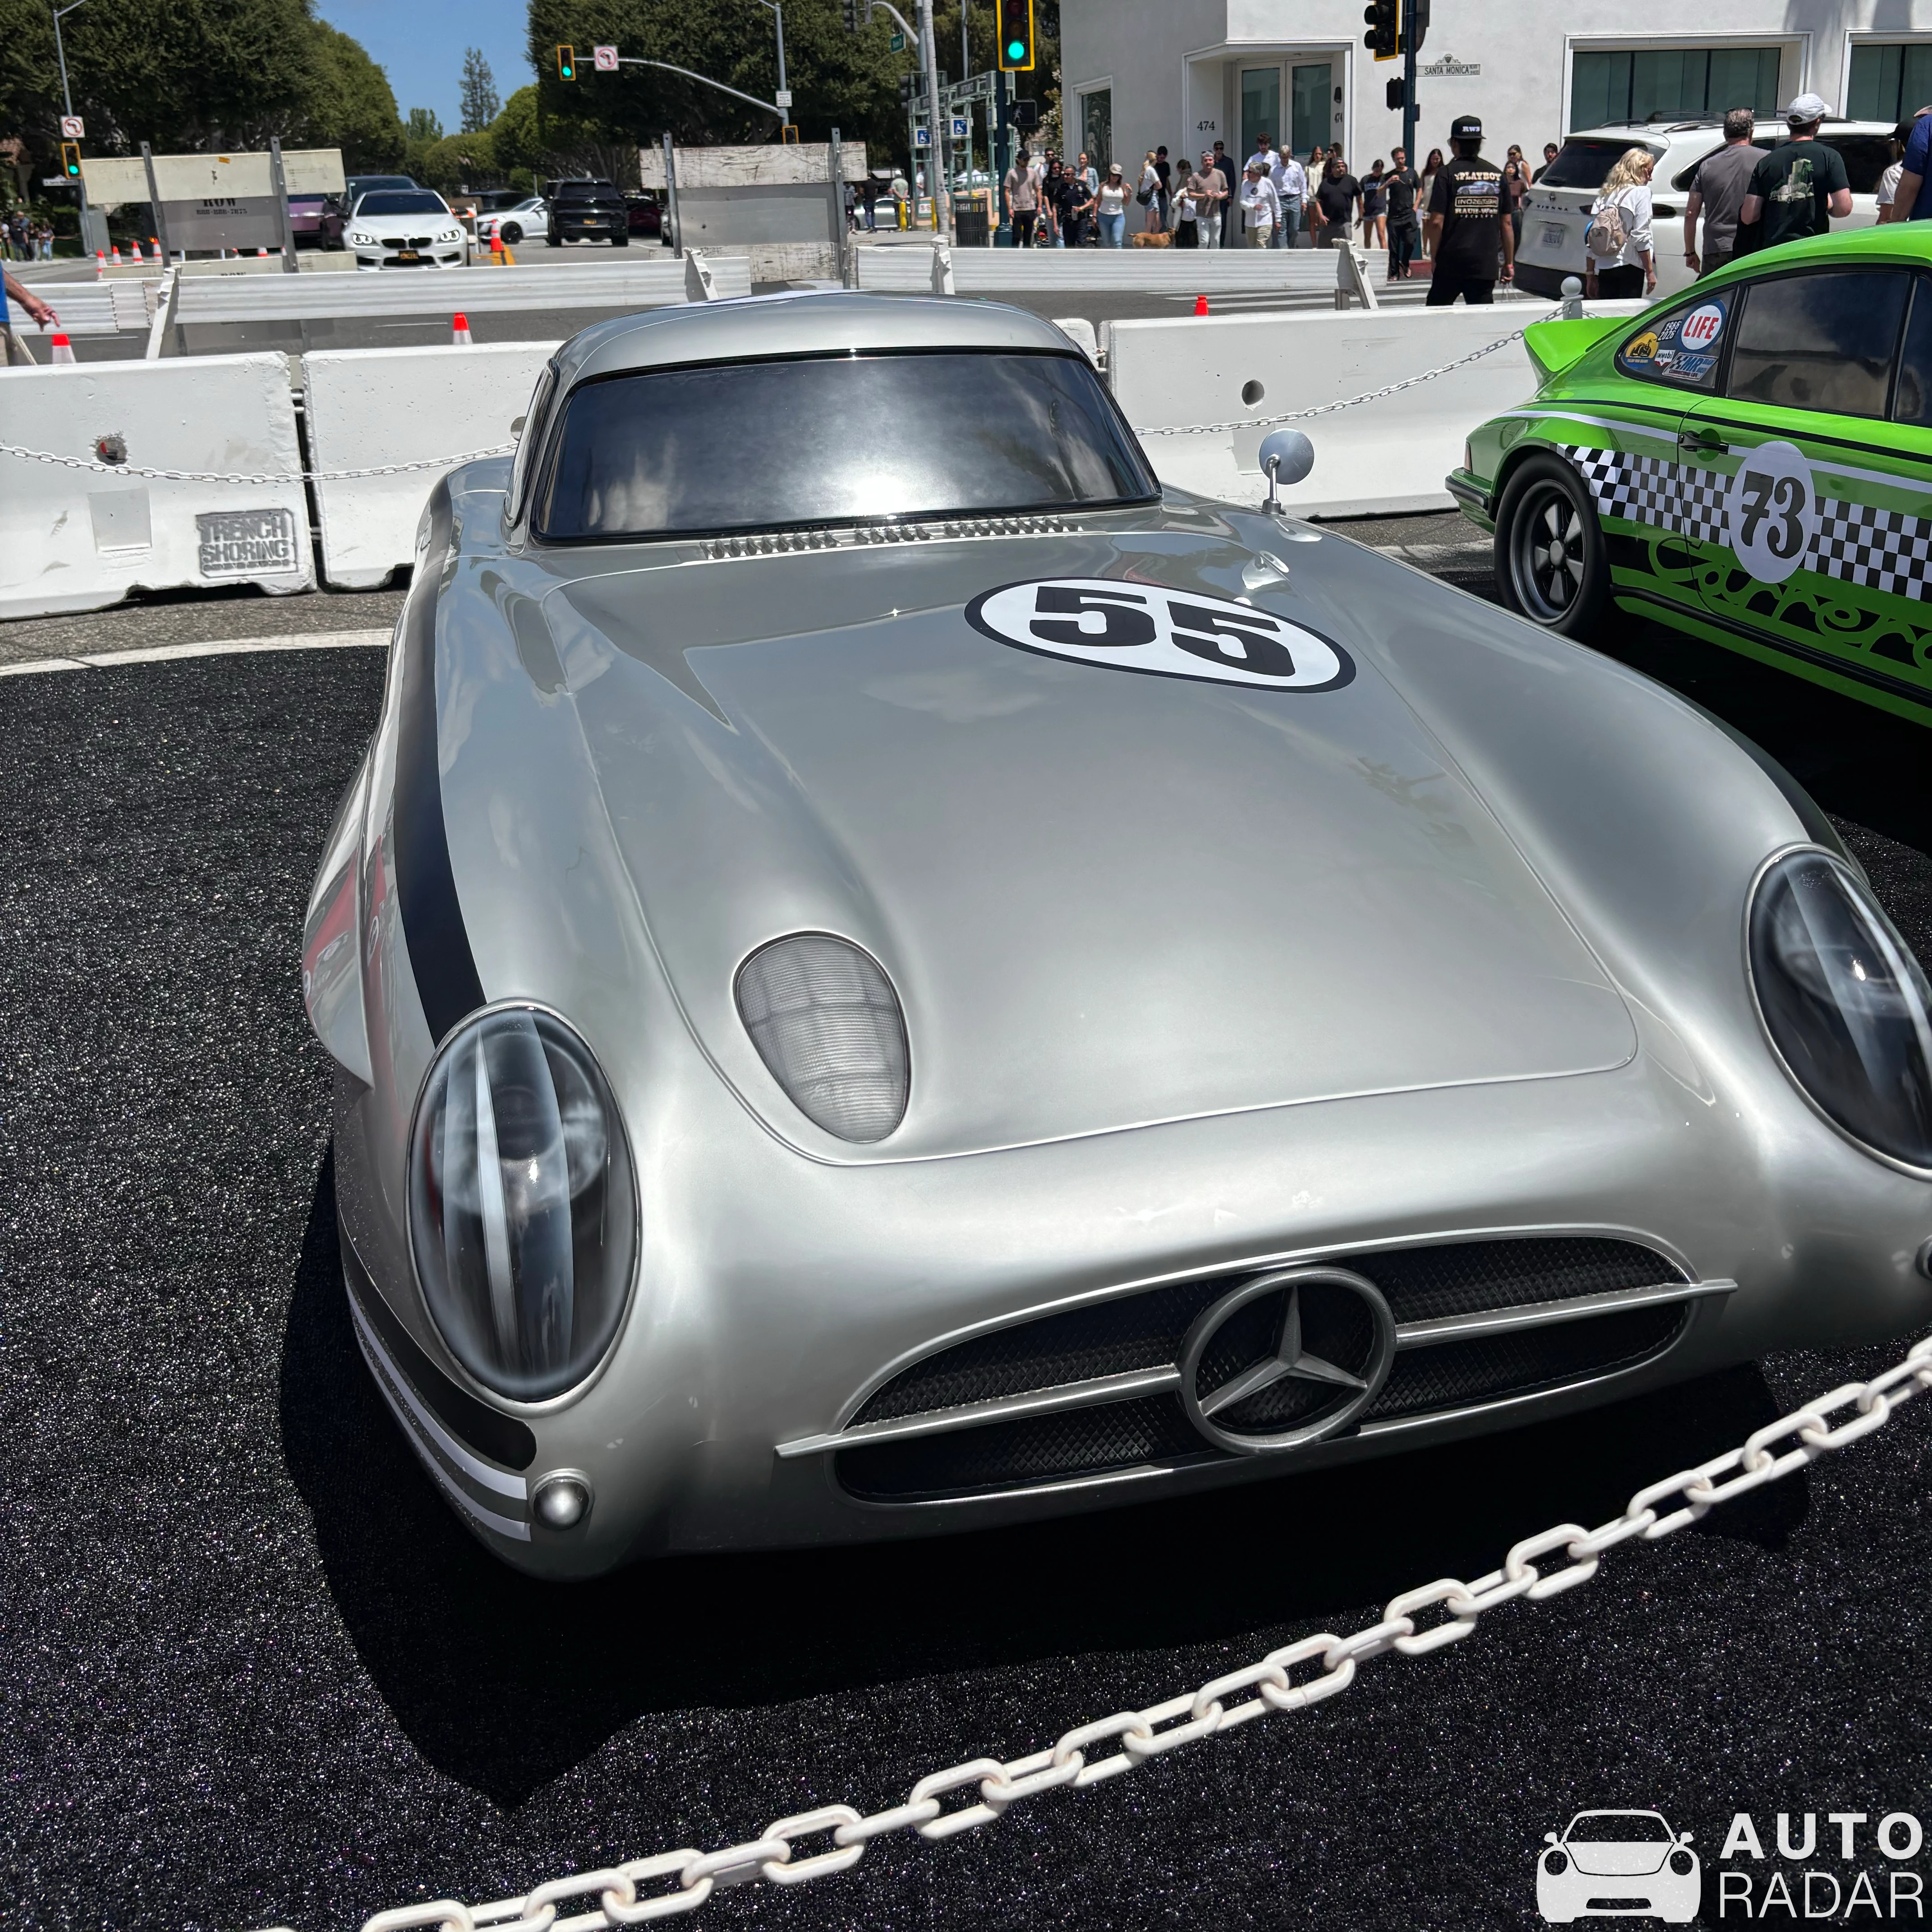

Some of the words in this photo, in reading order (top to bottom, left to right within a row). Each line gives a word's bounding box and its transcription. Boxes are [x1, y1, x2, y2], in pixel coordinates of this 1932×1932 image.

[1424, 67, 1443, 75] SANTA
[1446, 66, 1469, 74] MONICA
[1196, 121, 1215, 131] 474
[1658, 330, 1676, 340] 2026
[1684, 316, 1719, 340] LIFE
[1679, 356, 1704, 373] MR
[1740, 470, 1806, 559] 73
[201, 517, 288, 543] TRENCH
[202, 539, 290, 563] SHORING
[1029, 586, 1296, 677] 55
